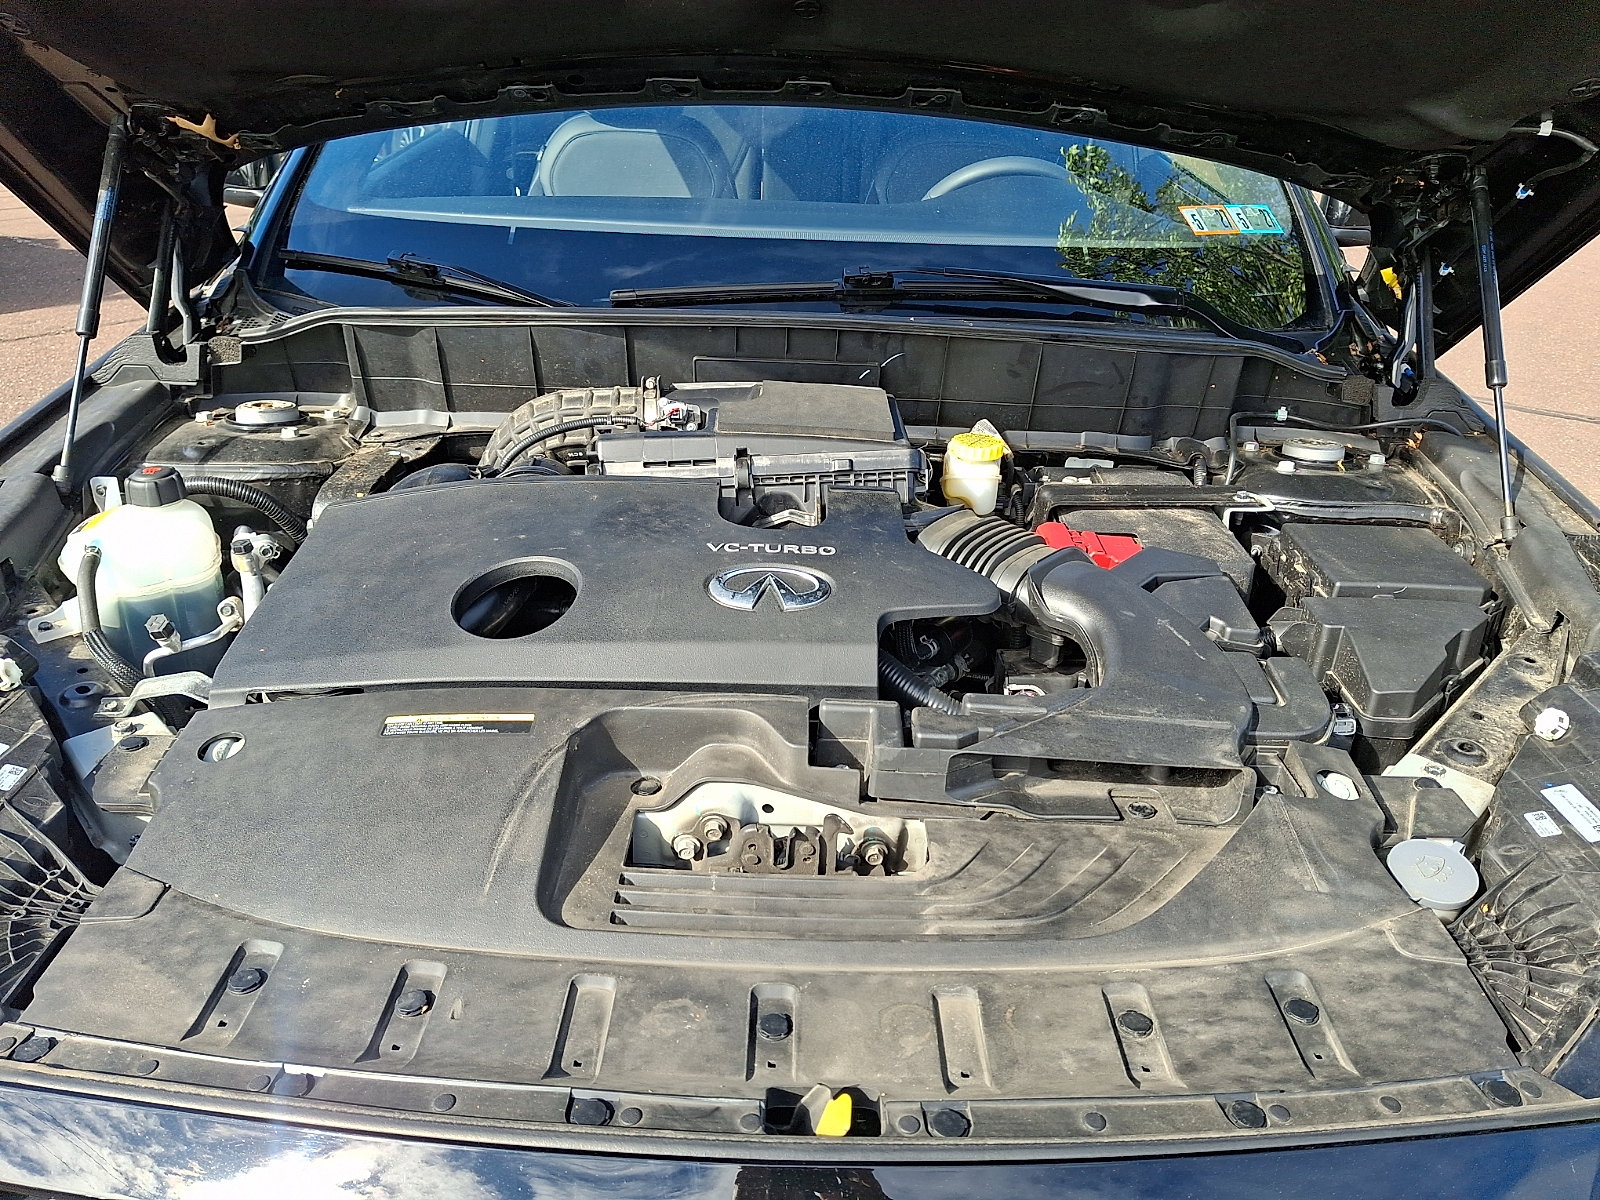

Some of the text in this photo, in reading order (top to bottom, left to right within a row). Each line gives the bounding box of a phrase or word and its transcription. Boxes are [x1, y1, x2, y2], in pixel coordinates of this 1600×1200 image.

[1190, 213, 1205, 230] 5
[1235, 212, 1250, 230] 5
[706, 542, 837, 556] VC-TURBO
